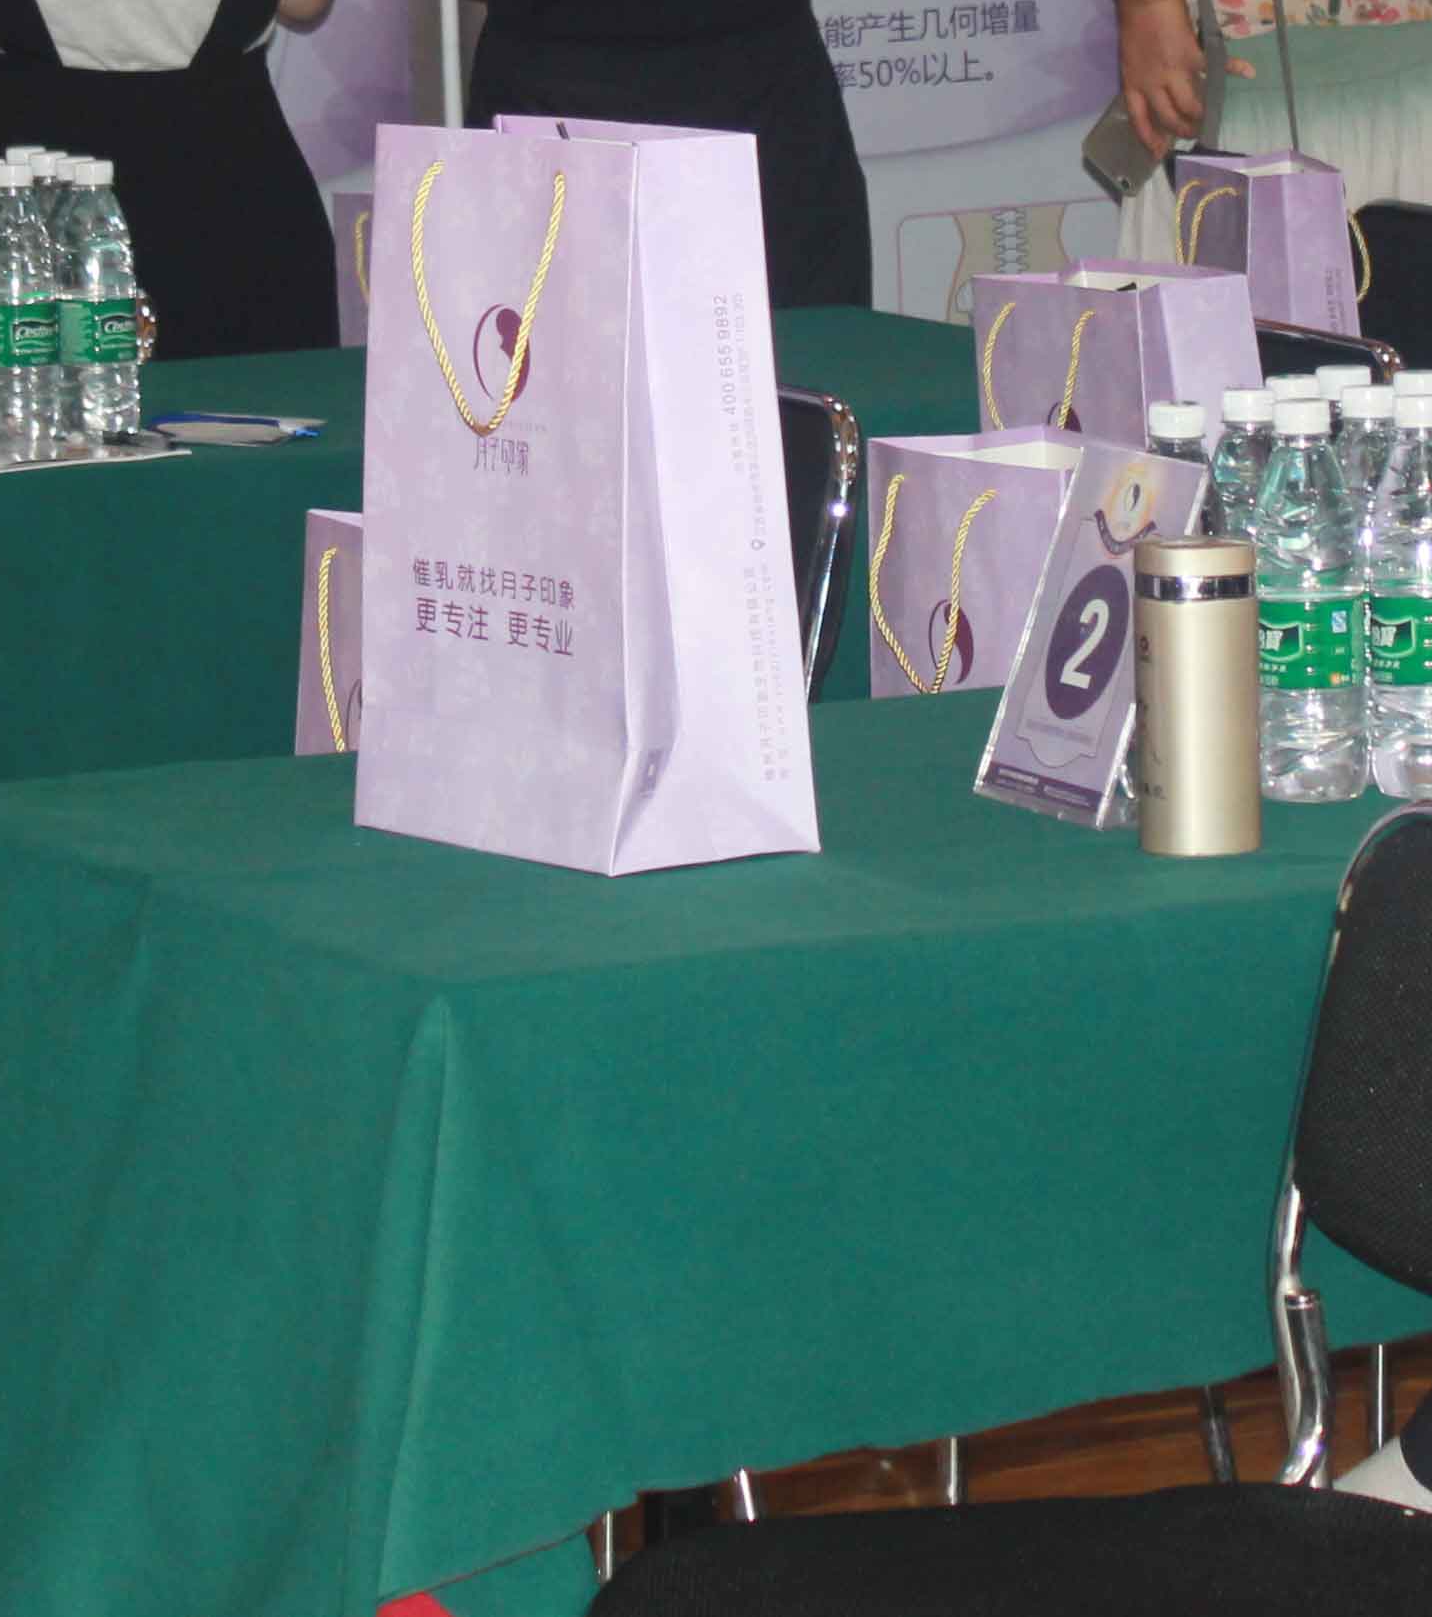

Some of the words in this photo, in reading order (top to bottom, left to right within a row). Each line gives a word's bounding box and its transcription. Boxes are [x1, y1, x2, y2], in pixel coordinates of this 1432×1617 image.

[412, 558, 575, 610] 催乳就找月子印象
[415, 596, 489, 642] 更专注
[505, 609, 574, 657] 更专业
[1059, 598, 1110, 691] 2
